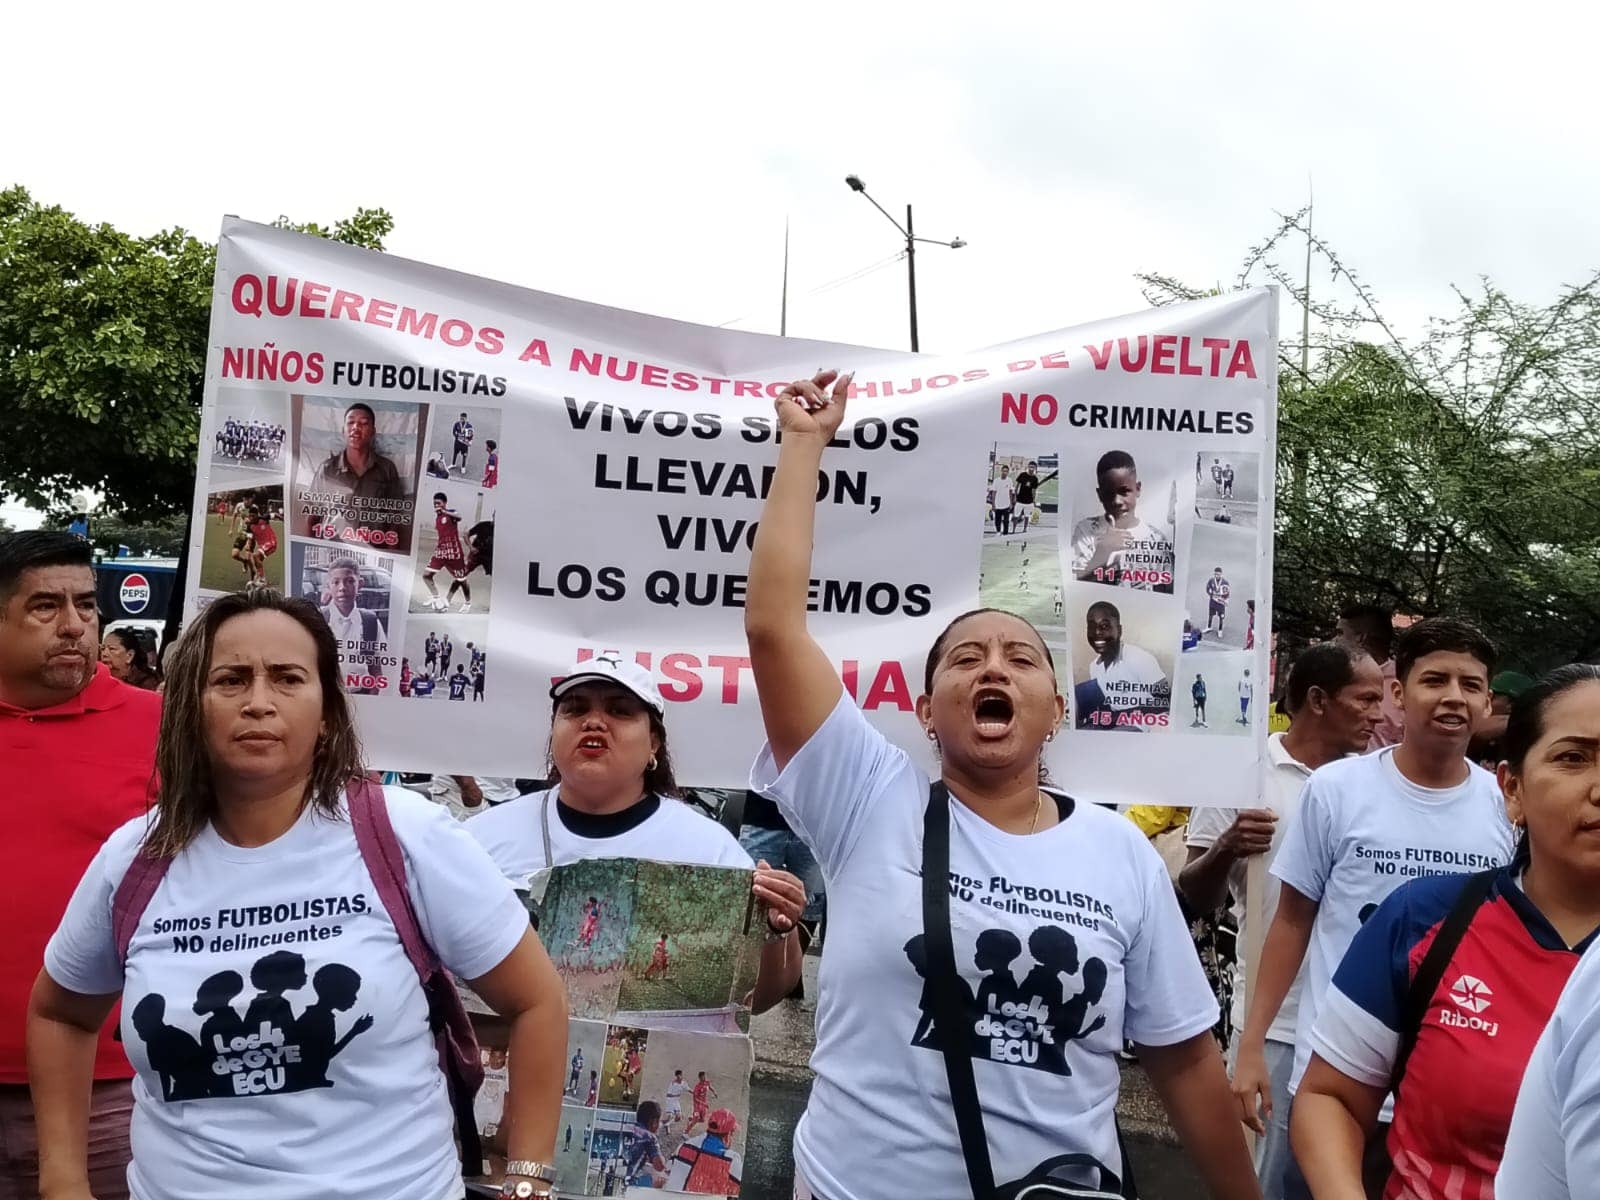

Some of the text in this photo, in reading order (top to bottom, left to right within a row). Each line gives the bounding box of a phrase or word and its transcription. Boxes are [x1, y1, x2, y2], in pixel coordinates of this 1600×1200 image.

[231, 273, 1258, 399] QUEREMOS A NUESTRO HIJOS DE VUELTA
[221, 342, 507, 397] NIÑOS FUTBOLISTAS
[564, 396, 722, 440] VIVOS
[741, 416, 783, 445] S
[1000, 392, 1254, 435] NO CRIMINALES
[594, 453, 882, 514] LLEVAN,
[352, 496, 413, 511] EDUARDO
[301, 505, 412, 525] ARROYO BUSTOS
[312, 523, 399, 545] 15 AÑOS
[657, 514, 758, 554] VIV
[1124, 541, 1172, 551] STEVEN
[1125, 554, 1171, 564] MEDINA
[1094, 567, 1115, 581] 11
[122, 589, 148, 598] PEPSI
[527, 562, 931, 618] LOS QUEMOS
[347, 640, 388, 652] DIDIER
[349, 654, 398, 666] BUSTOS
[346, 671, 389, 689] ÑOS
[1105, 682, 1169, 694] NEHEMIAS
[1104, 696, 1170, 708] ARBOLEDA
[1090, 710, 1170, 727] 15 AÑOS
[1355, 846, 1401, 860] Somos
[1374, 861, 1396, 875] NO
[154, 893, 372, 934] Somos FUTBOLISTAS,
[945, 882, 1099, 931] NO delincuentes
[173, 924, 343, 953] NO delincuentes
[990, 1038, 1039, 1063] ECU
[232, 1066, 286, 1095] ECU
